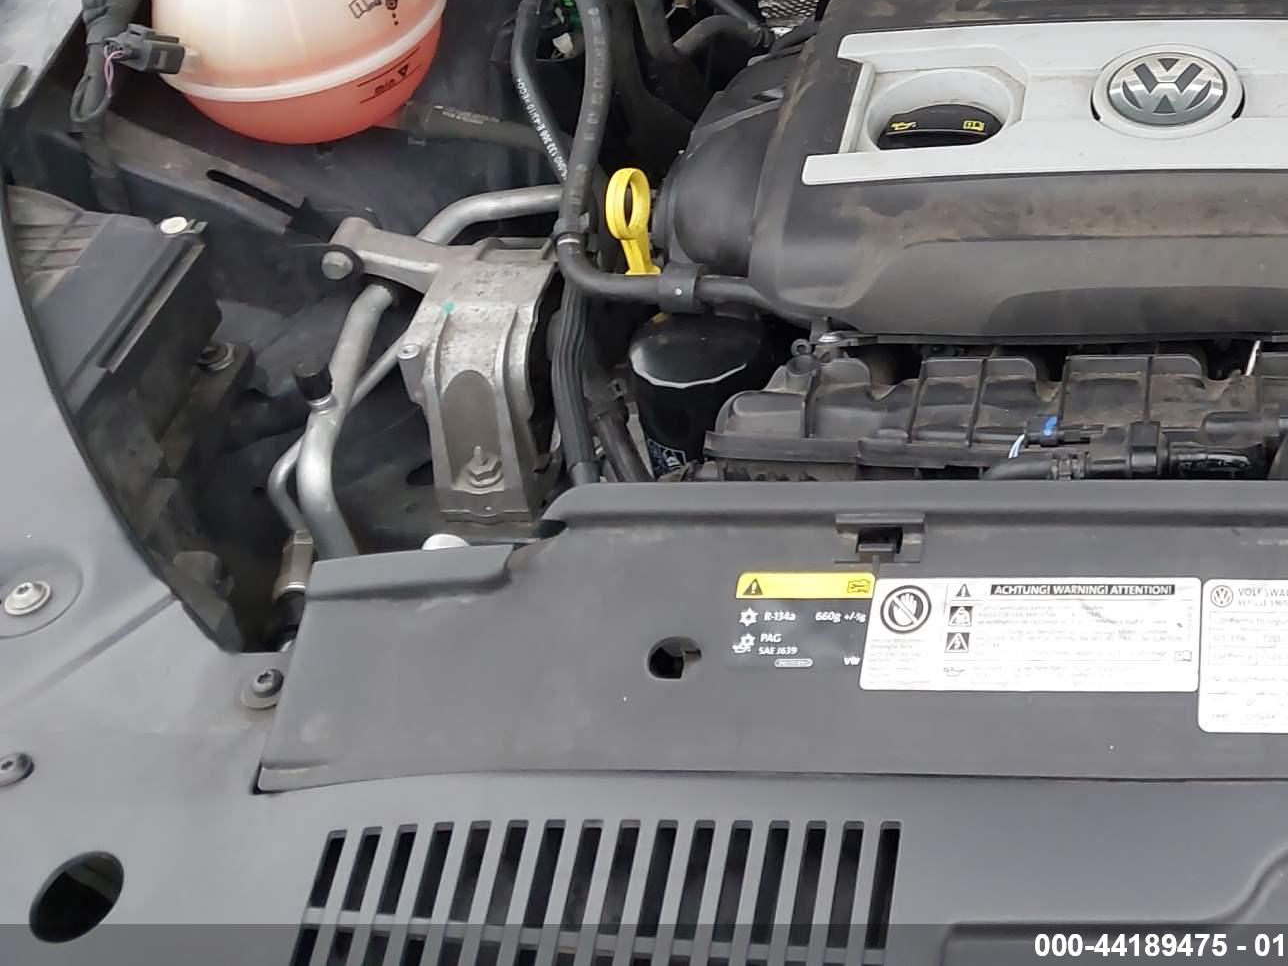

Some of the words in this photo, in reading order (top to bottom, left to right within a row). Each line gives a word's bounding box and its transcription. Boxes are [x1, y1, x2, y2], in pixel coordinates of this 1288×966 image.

[994, 584, 1051, 595] ACHTUNG!
[1053, 584, 1109, 595] WARNING!
[1111, 585, 1173, 595] ATTENTION!
[763, 610, 797, 622] R-134a
[815, 611, 842, 623] 660g
[760, 633, 782, 643] PAG
[758, 646, 775, 655] SAE
[776, 646, 798, 655] J639
